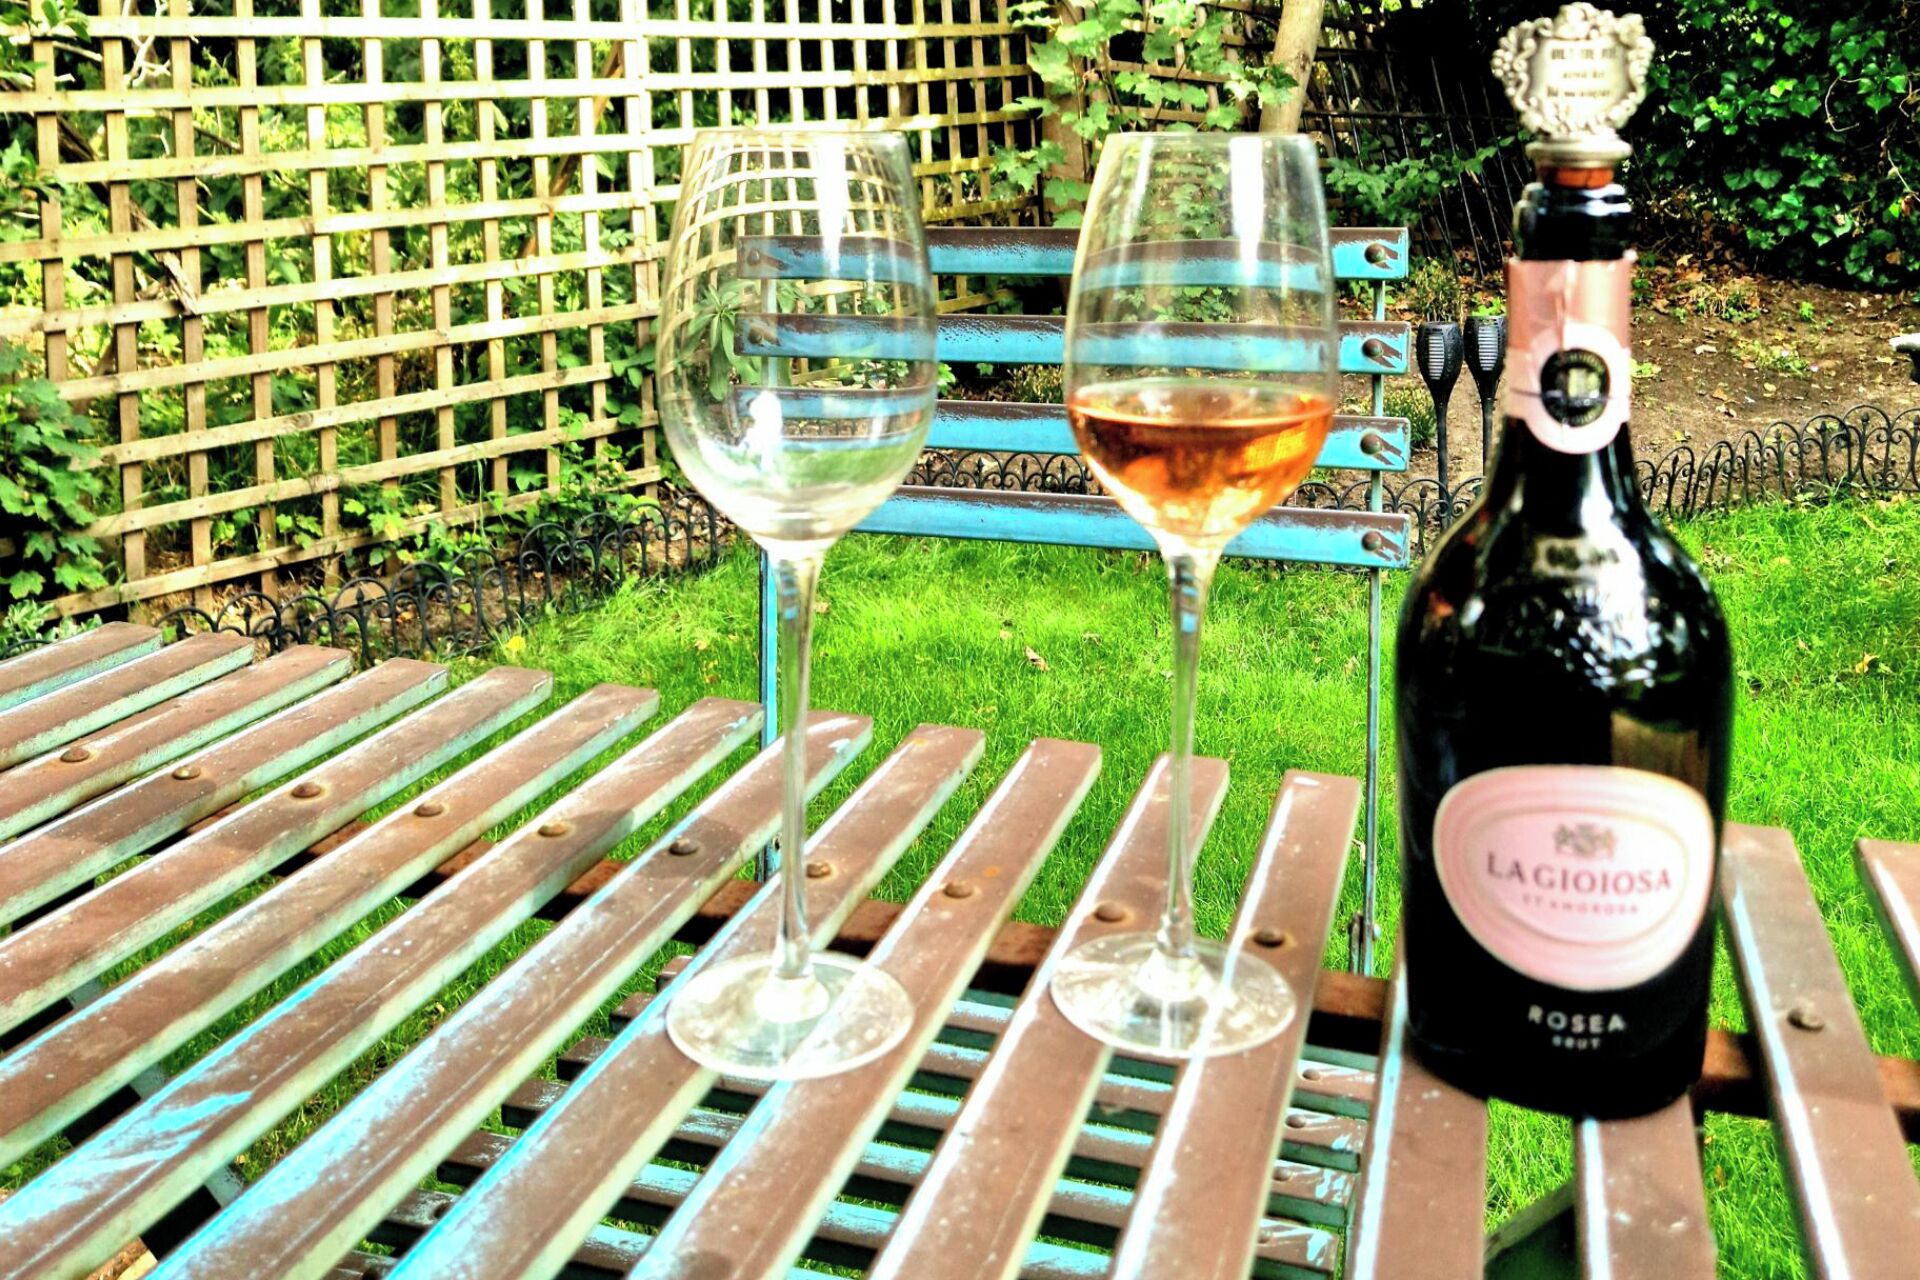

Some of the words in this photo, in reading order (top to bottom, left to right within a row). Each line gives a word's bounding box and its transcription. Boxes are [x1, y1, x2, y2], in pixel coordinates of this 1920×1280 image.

[1487, 851, 1526, 884] LA
[1532, 863, 1671, 895] GIOIOSA
[1528, 1004, 1626, 1034] ROSEA
